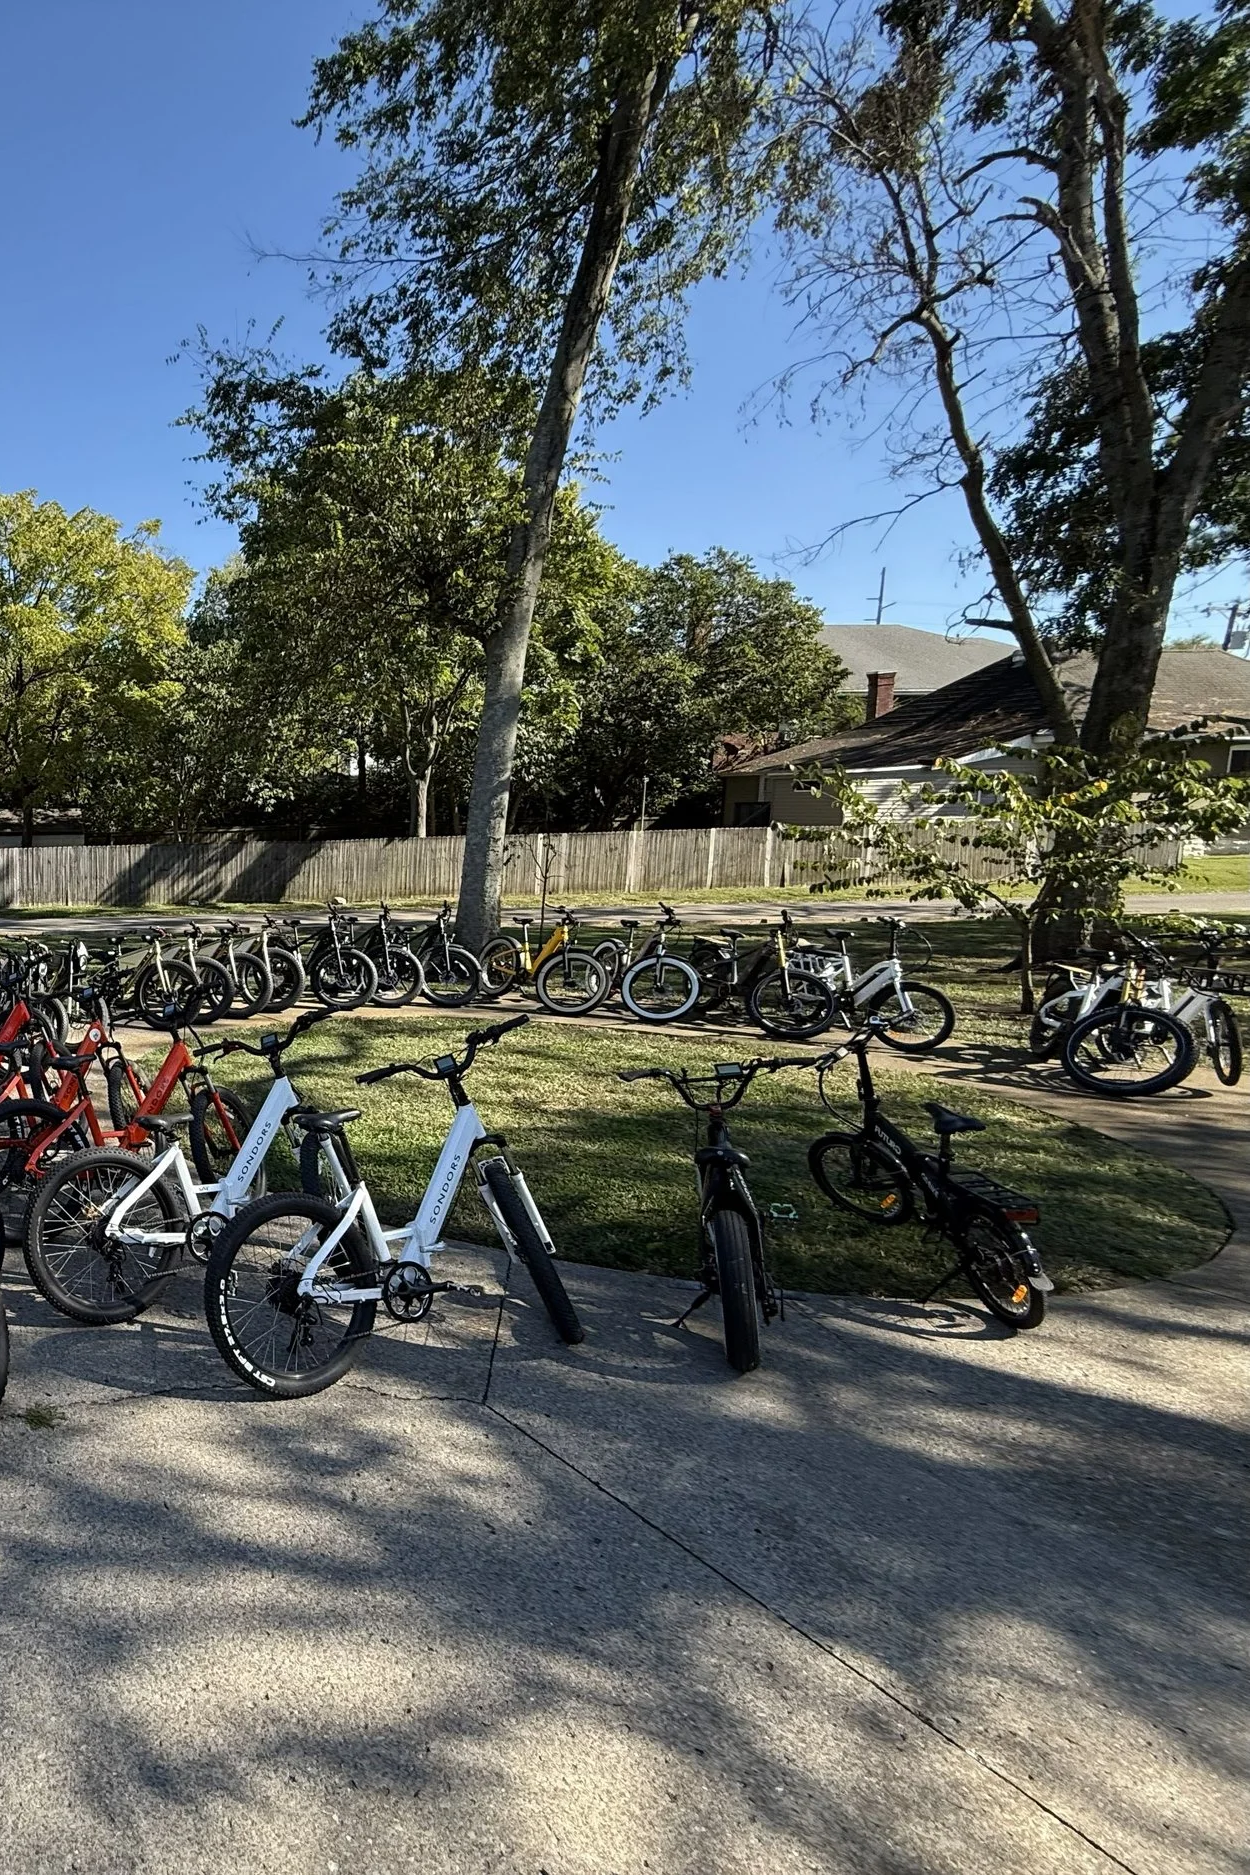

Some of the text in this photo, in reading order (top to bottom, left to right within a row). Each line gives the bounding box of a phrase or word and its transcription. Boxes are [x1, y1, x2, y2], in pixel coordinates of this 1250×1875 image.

[237, 1120, 272, 1183] SONDORS
[429, 1154, 461, 1225] SONDORS
[219, 1279, 235, 1346] 27.5x3.0
[253, 1370, 276, 1387] CST
